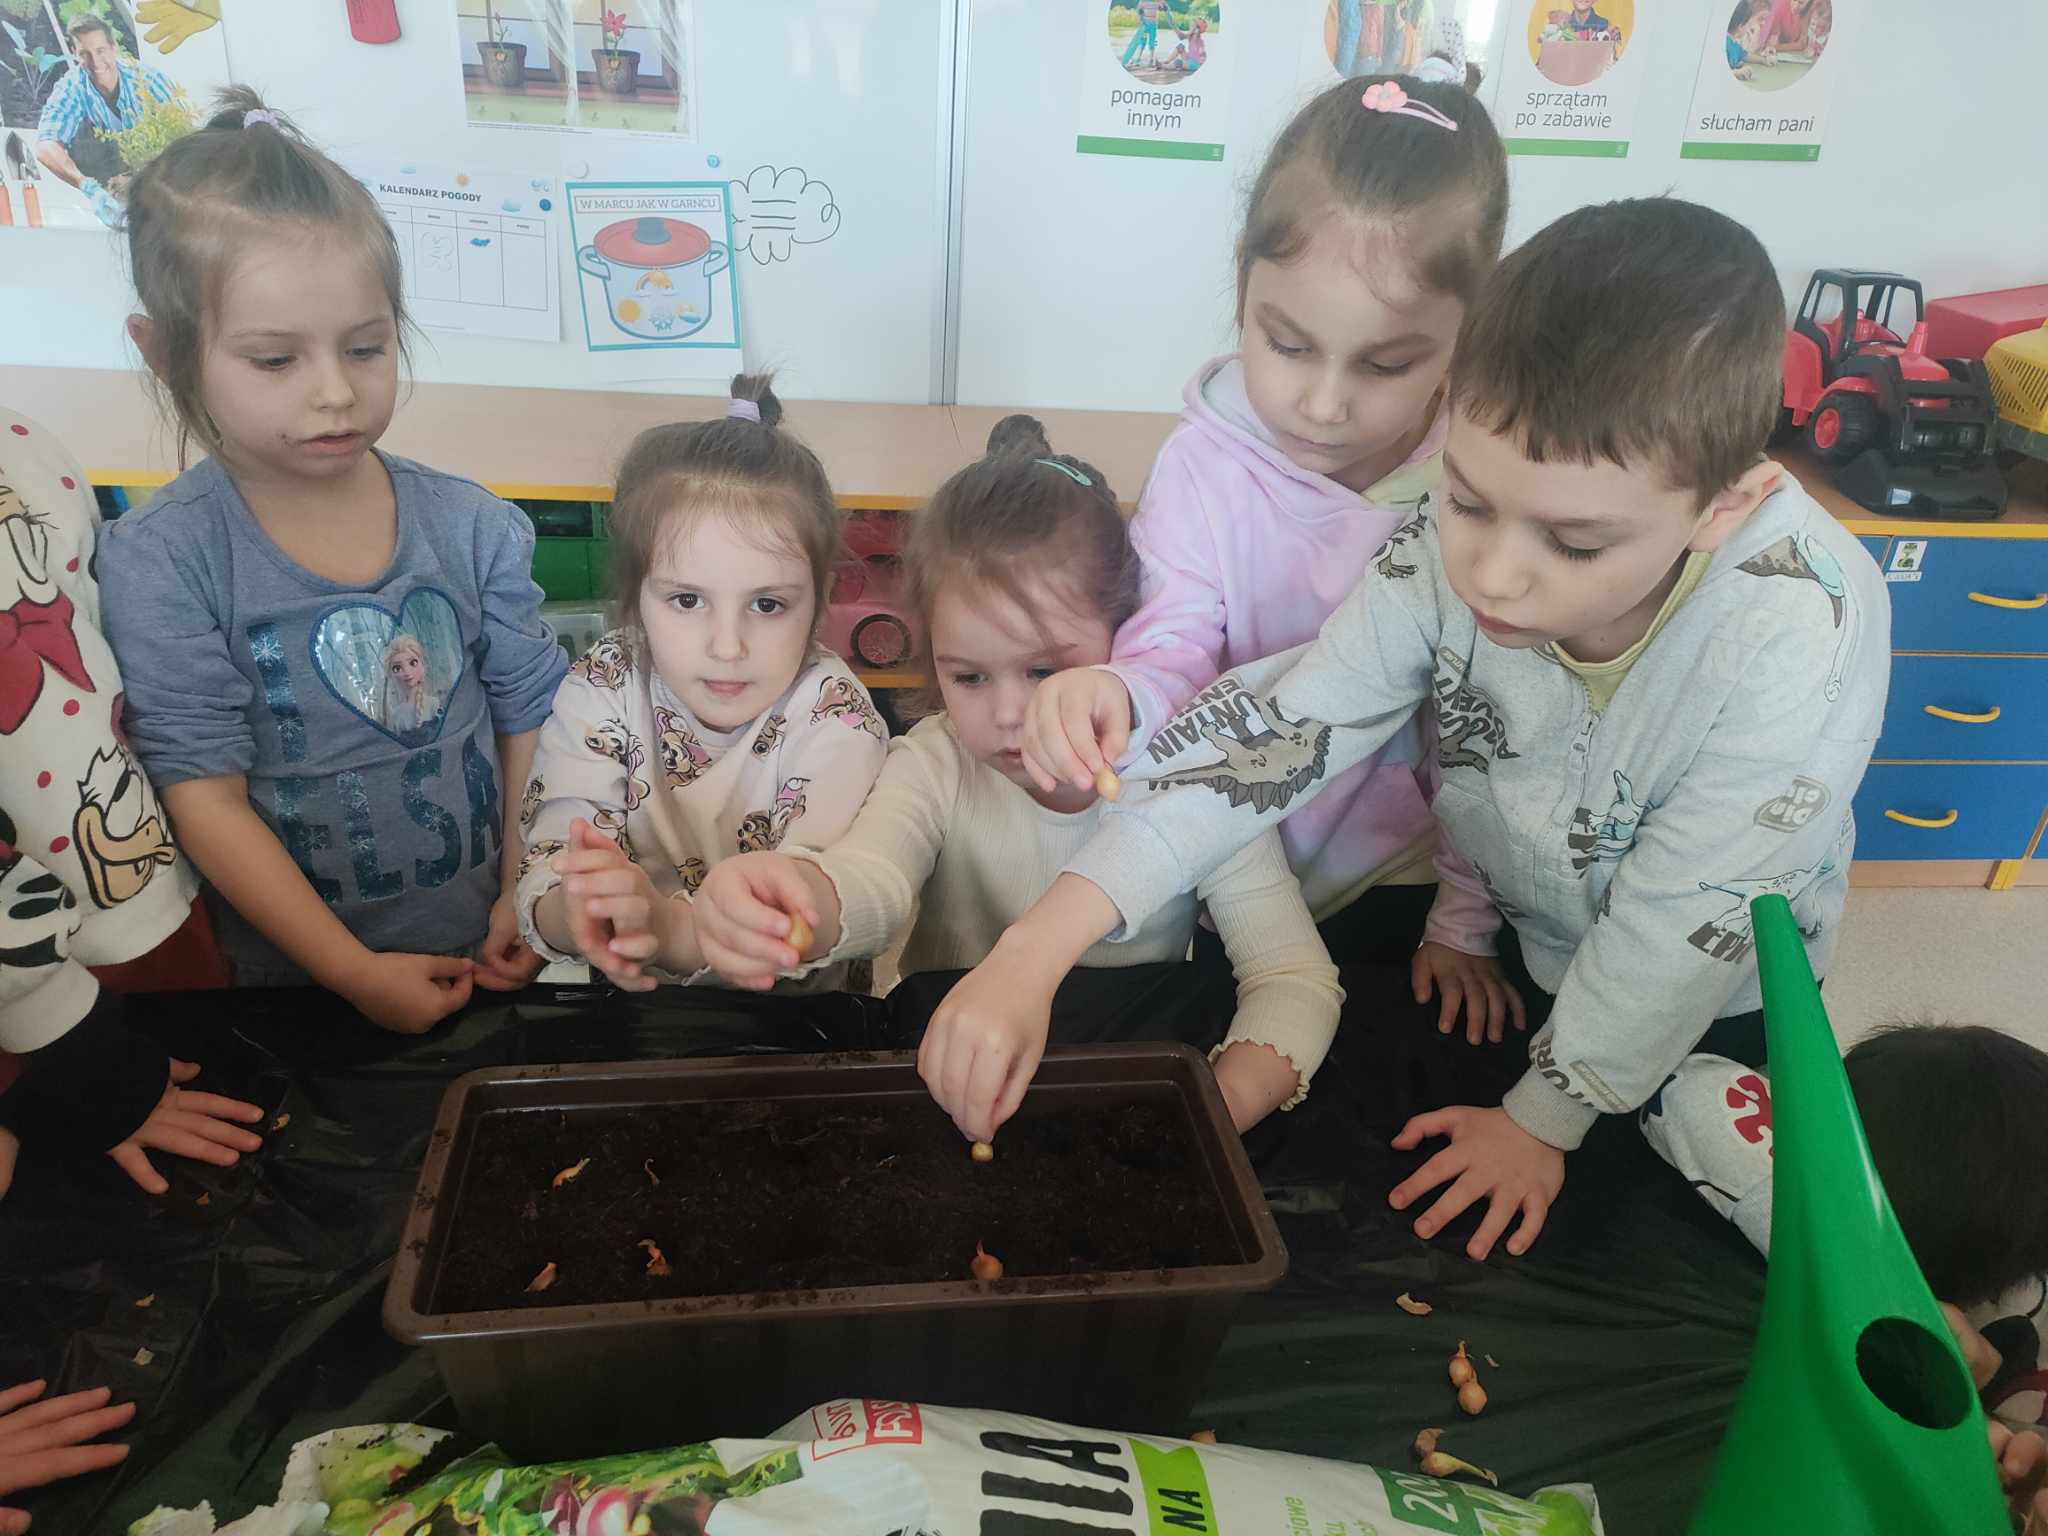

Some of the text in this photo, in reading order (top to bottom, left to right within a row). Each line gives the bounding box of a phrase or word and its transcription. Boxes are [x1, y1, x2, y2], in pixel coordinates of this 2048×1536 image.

[1110, 89, 1202, 111] pomagam
[1526, 91, 1608, 110] sprzątam
[1127, 109, 1182, 131] innym
[1515, 111, 1612, 128] po zabawie
[1700, 113, 1815, 135] słucham pani
[379, 183, 482, 202] KALENDARZ POGODY
[579, 199, 716, 209] W MARCU JAK W GARNCU
[273, 733, 502, 904] ELSA
[1157, 1487, 1208, 1533] NA
